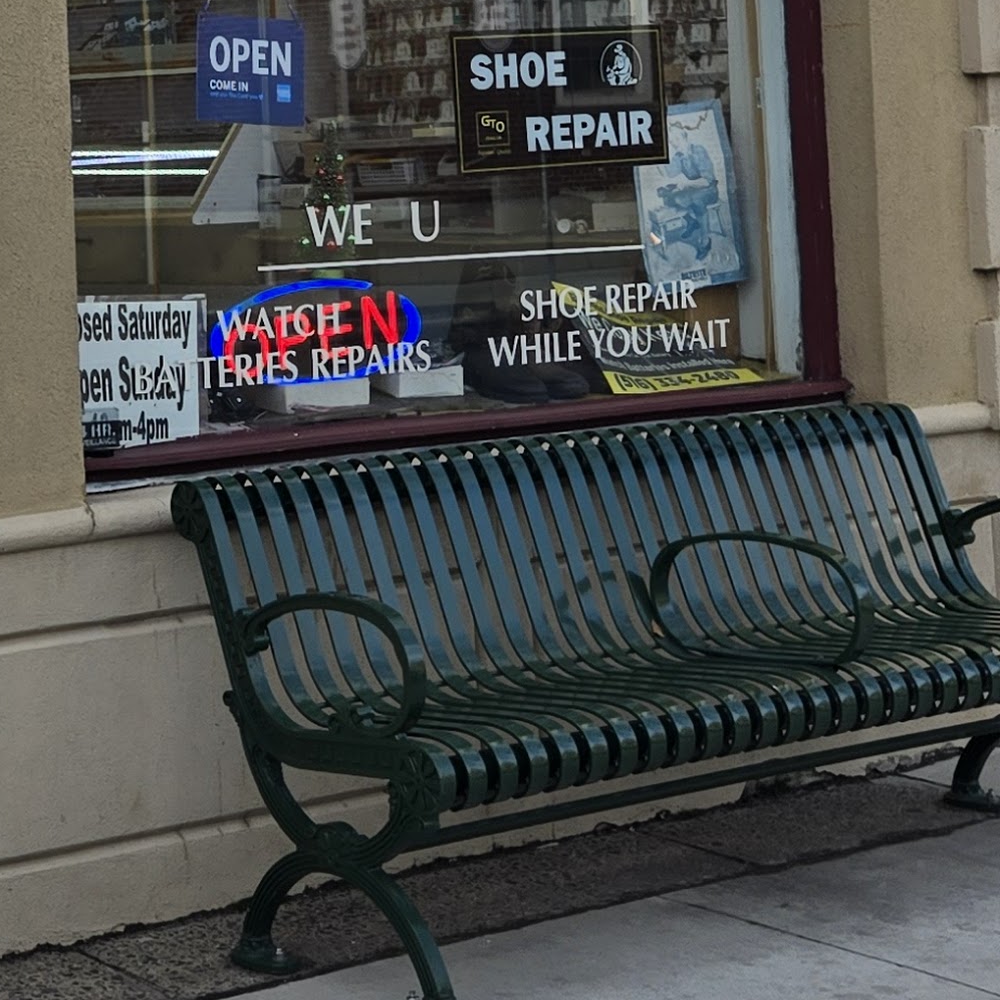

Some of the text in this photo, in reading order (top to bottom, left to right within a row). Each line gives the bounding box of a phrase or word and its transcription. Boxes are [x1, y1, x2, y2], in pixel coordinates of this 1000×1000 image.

[209, 35, 292, 77] OPEN
[470, 50, 568, 91] SHOE
[209, 79, 249, 93] COME IN
[480, 114, 506, 134] GTO
[525, 110, 653, 152] REPAIR
[305, 199, 441, 247] WE U
[519, 278, 698, 322] SHOE REPAIR
[117, 302, 192, 350] Saturday
[216, 303, 343, 342] WATCH
[224, 290, 400, 379] OPEN
[487, 330, 583, 368] WHILE
[588, 324, 652, 359] YOU
[660, 318, 731, 352] WAIT
[79, 366, 114, 408] pen
[134, 339, 433, 395] BATTERIES REPAIRS
